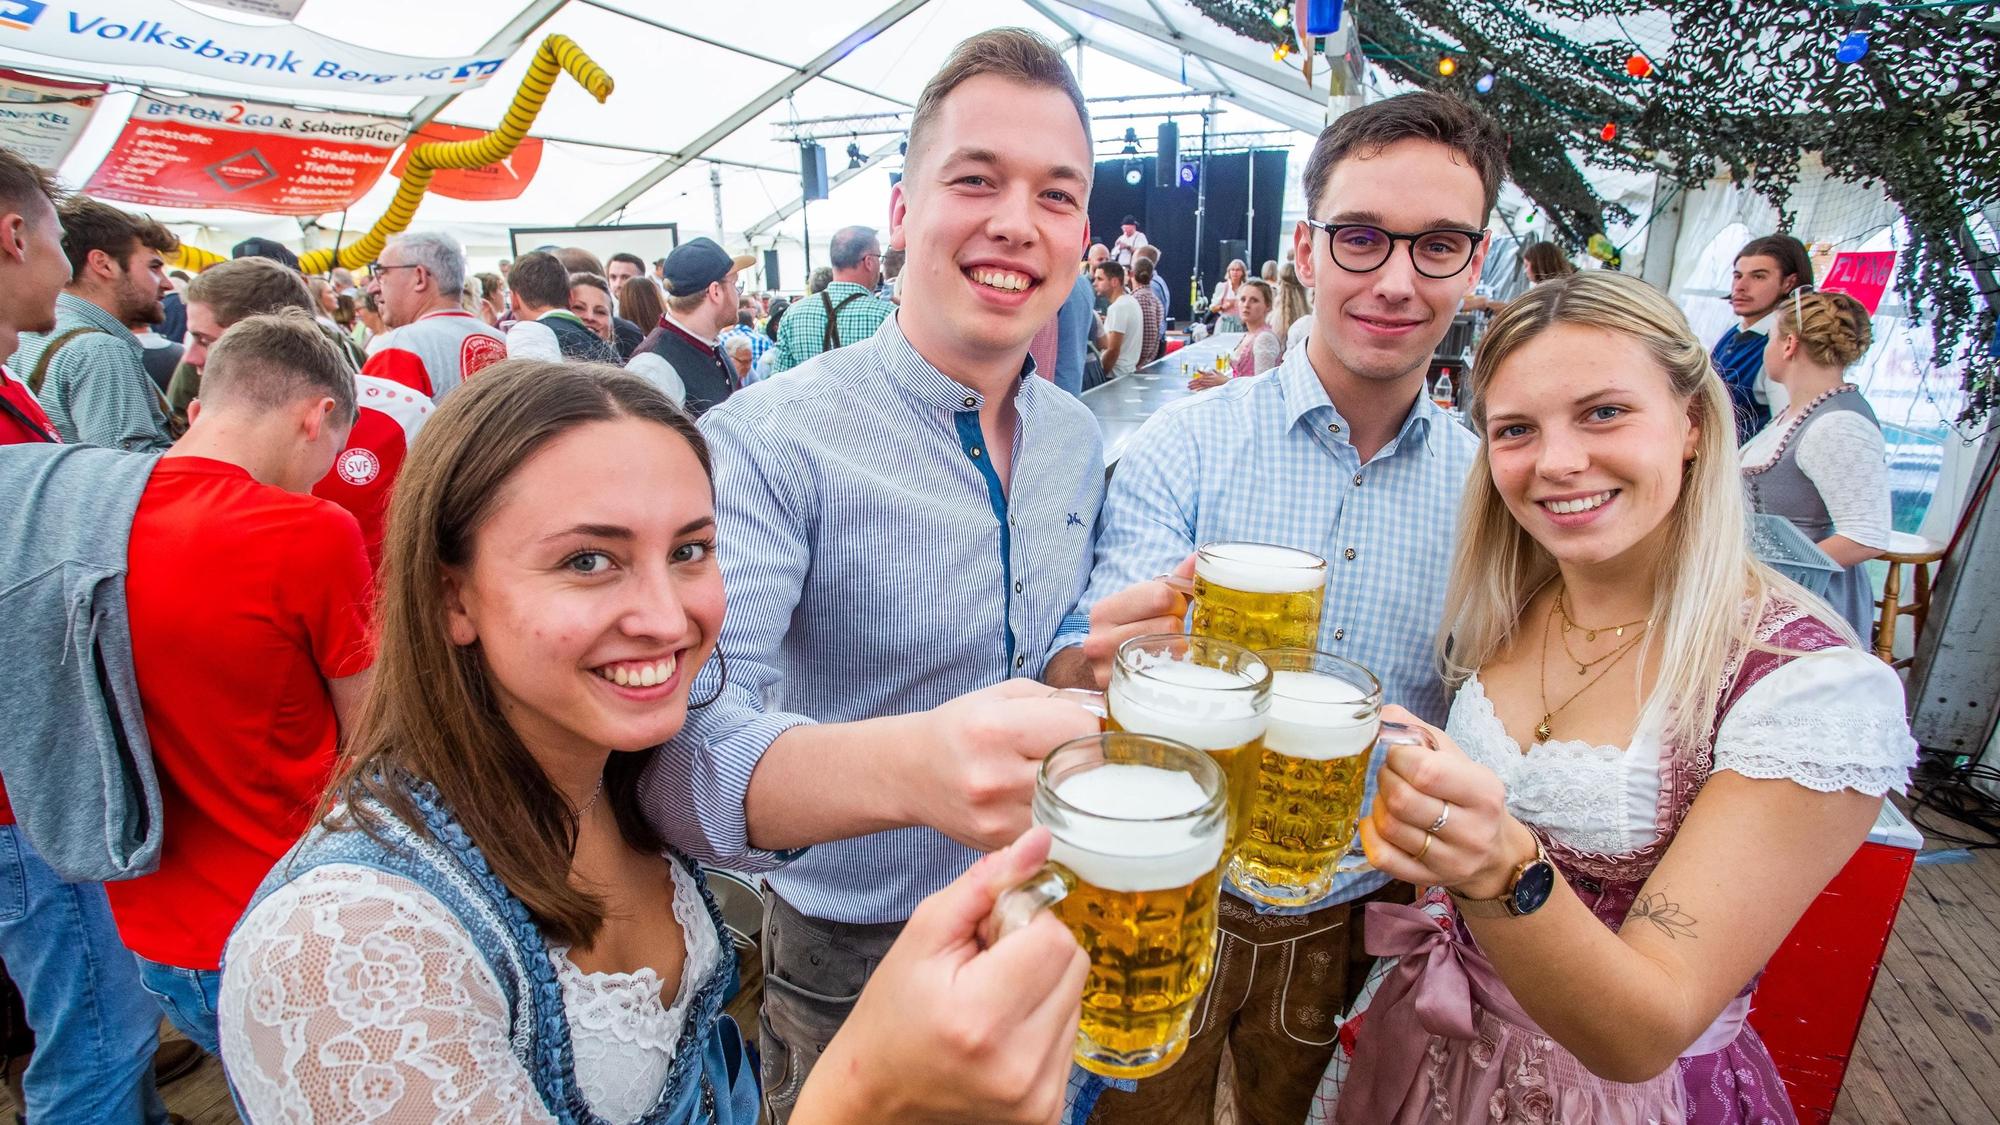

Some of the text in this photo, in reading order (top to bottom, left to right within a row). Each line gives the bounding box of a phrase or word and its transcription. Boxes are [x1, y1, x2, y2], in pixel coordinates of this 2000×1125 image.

[69, 11, 304, 74] Volksbank
[280, 116, 294, 129] &
[299, 119, 400, 143] Schüttgüter
[309, 147, 388, 164] Straßenbau
[304, 161, 356, 176] Tiefbau
[296, 175, 355, 187] Abbruch
[347, 460, 369, 473] SVF
